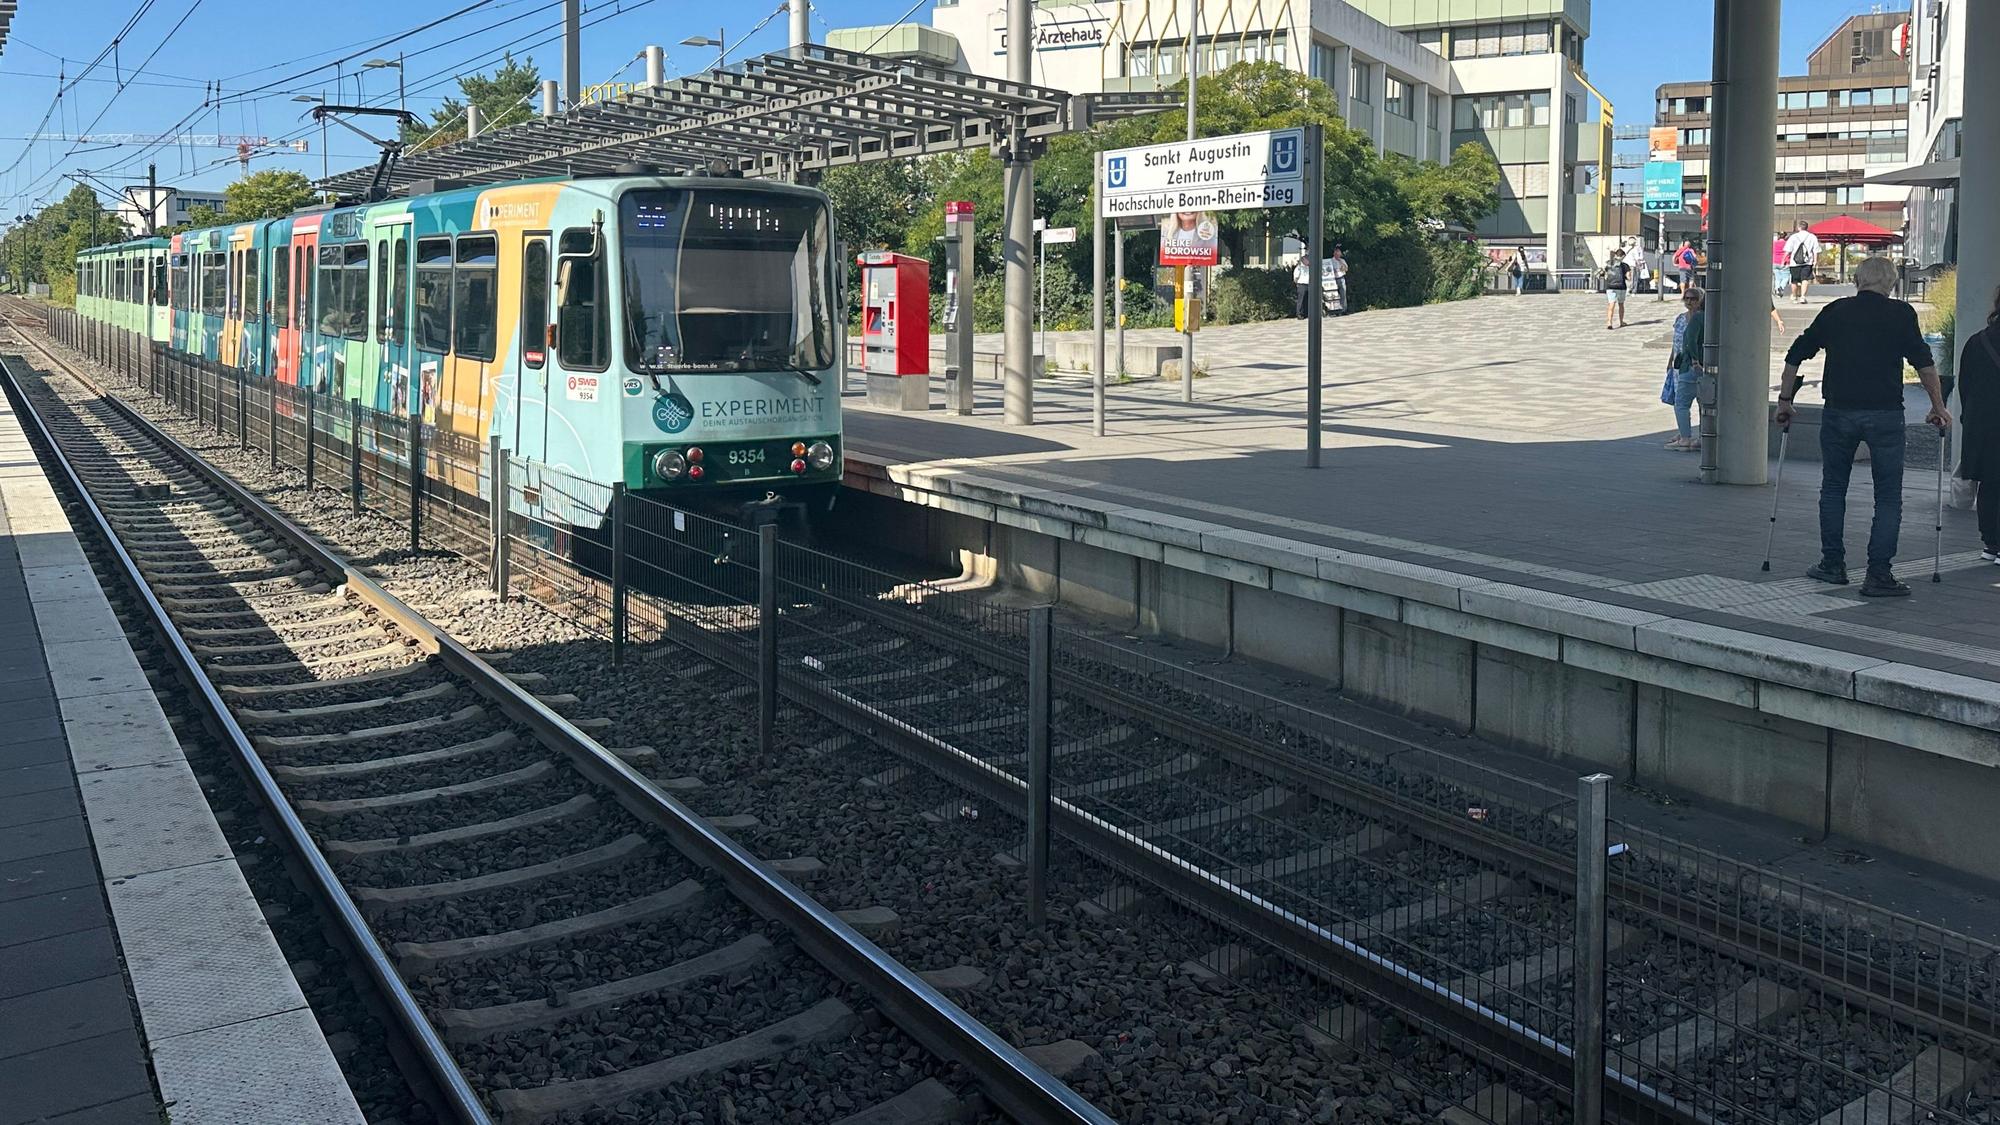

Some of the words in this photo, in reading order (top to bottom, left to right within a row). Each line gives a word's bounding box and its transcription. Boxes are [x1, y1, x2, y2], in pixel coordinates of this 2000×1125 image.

[1038, 27, 1102, 44] Ärztehaus
[1144, 152, 1181, 167] Sankt
[1189, 141, 1251, 163] Augustin
[1260, 164, 1269, 176] A
[1167, 169, 1224, 185] Zentrum
[1109, 194, 1174, 212] Hochschule
[1179, 185, 1294, 207] Bonn-Rhein-Sieg
[1164, 239, 1191, 247] HEIKE
[1164, 247, 1212, 256] BOROWSKI
[578, 377, 597, 387] SWB
[579, 391, 593, 400] 9354
[702, 397, 824, 417] EXPERIMENT
[703, 419, 726, 427] DEINE
[729, 449, 765, 464] 9354
